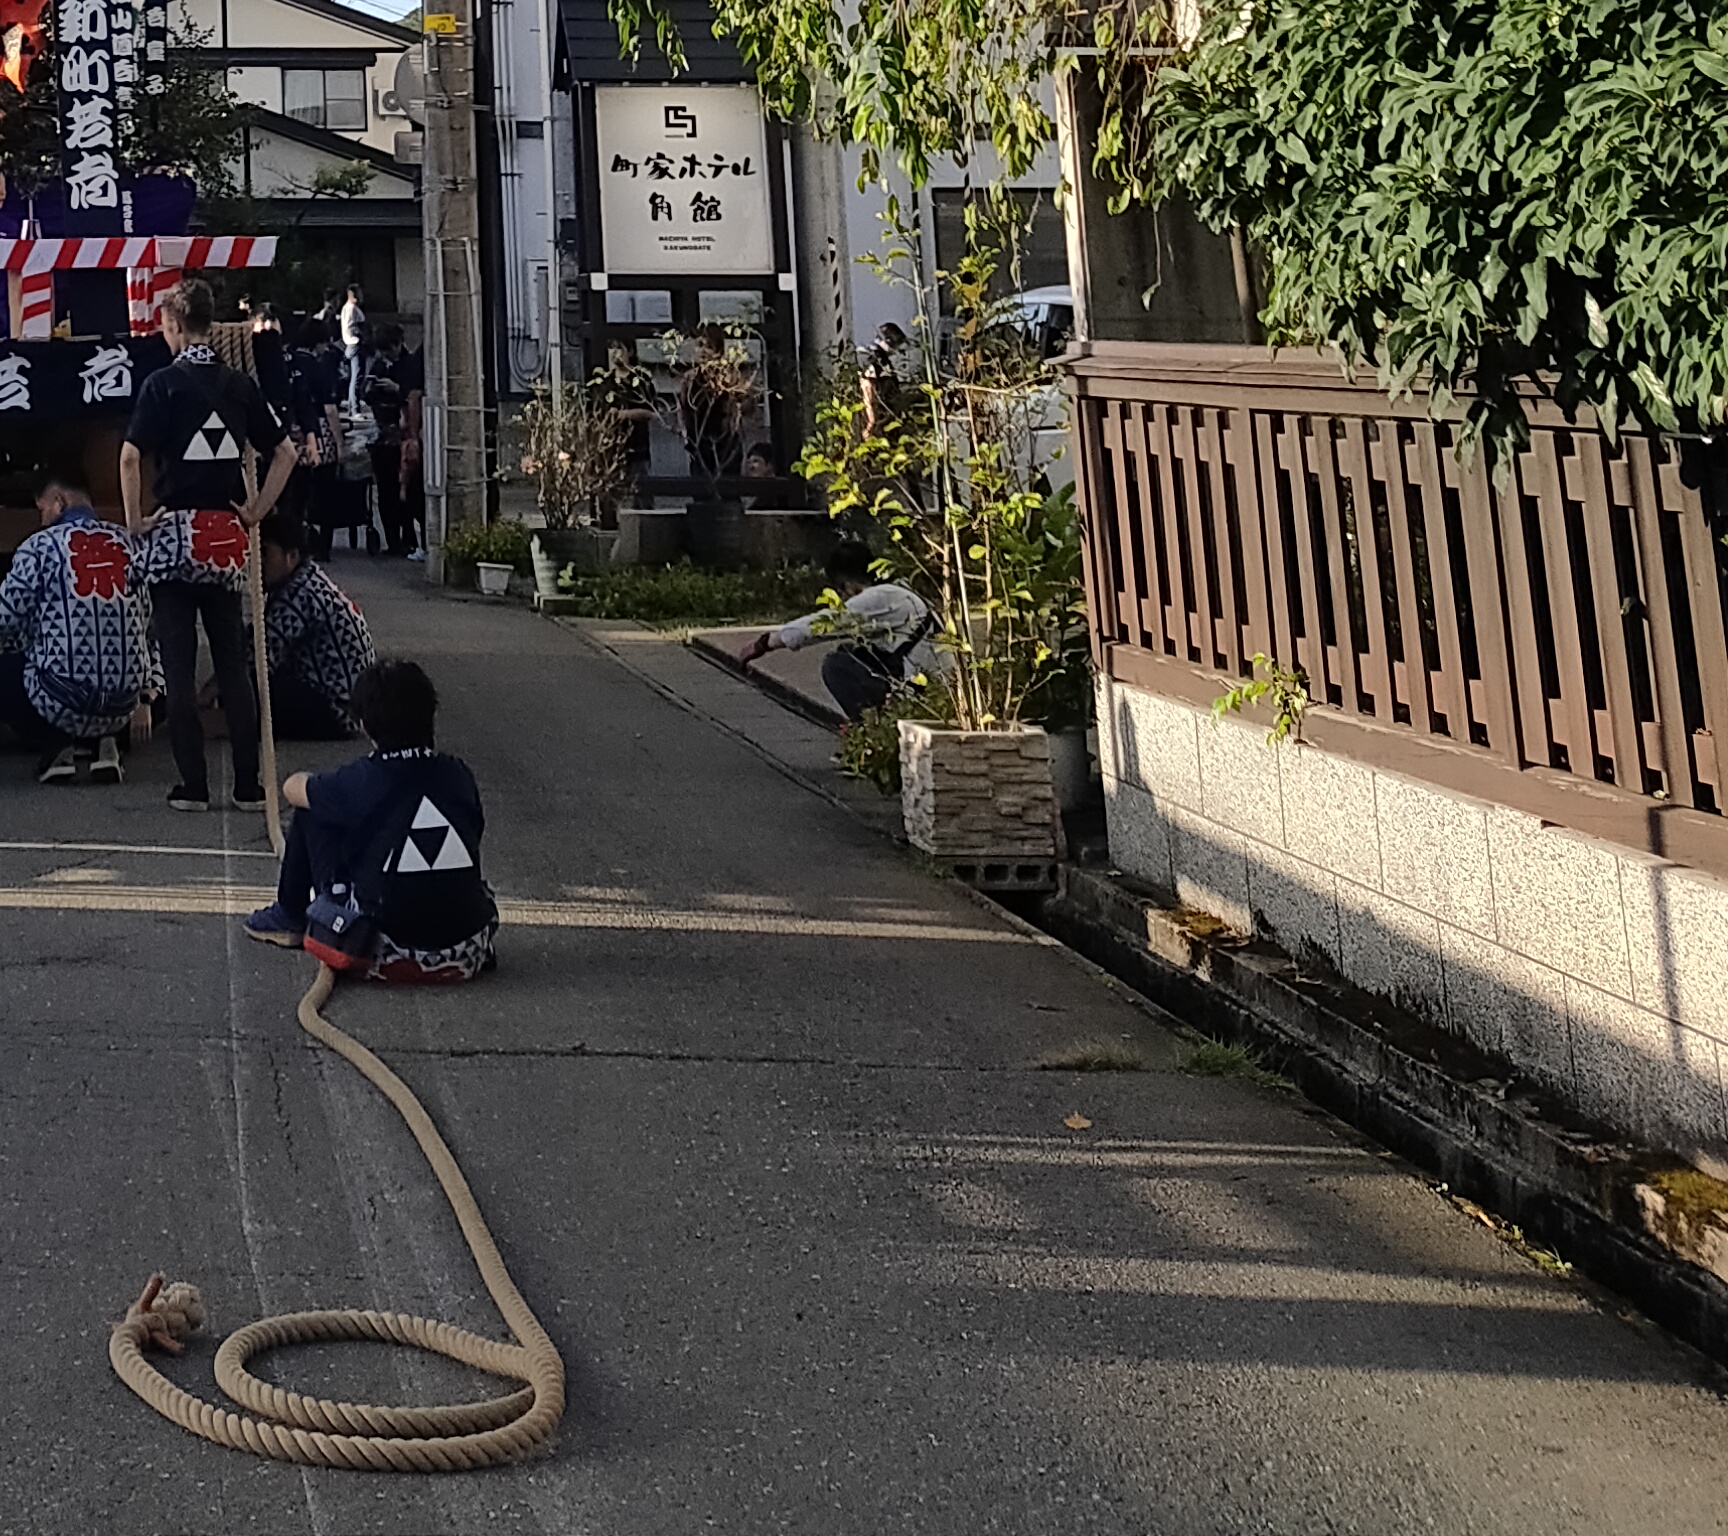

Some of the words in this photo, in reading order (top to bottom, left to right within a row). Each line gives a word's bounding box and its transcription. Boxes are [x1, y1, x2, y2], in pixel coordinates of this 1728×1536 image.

[610, 151, 757, 181] 町家ホテル
[648, 190, 723, 223] 角館
[691, 235, 716, 243] HOTEL
[68, 531, 131, 600] 祭
